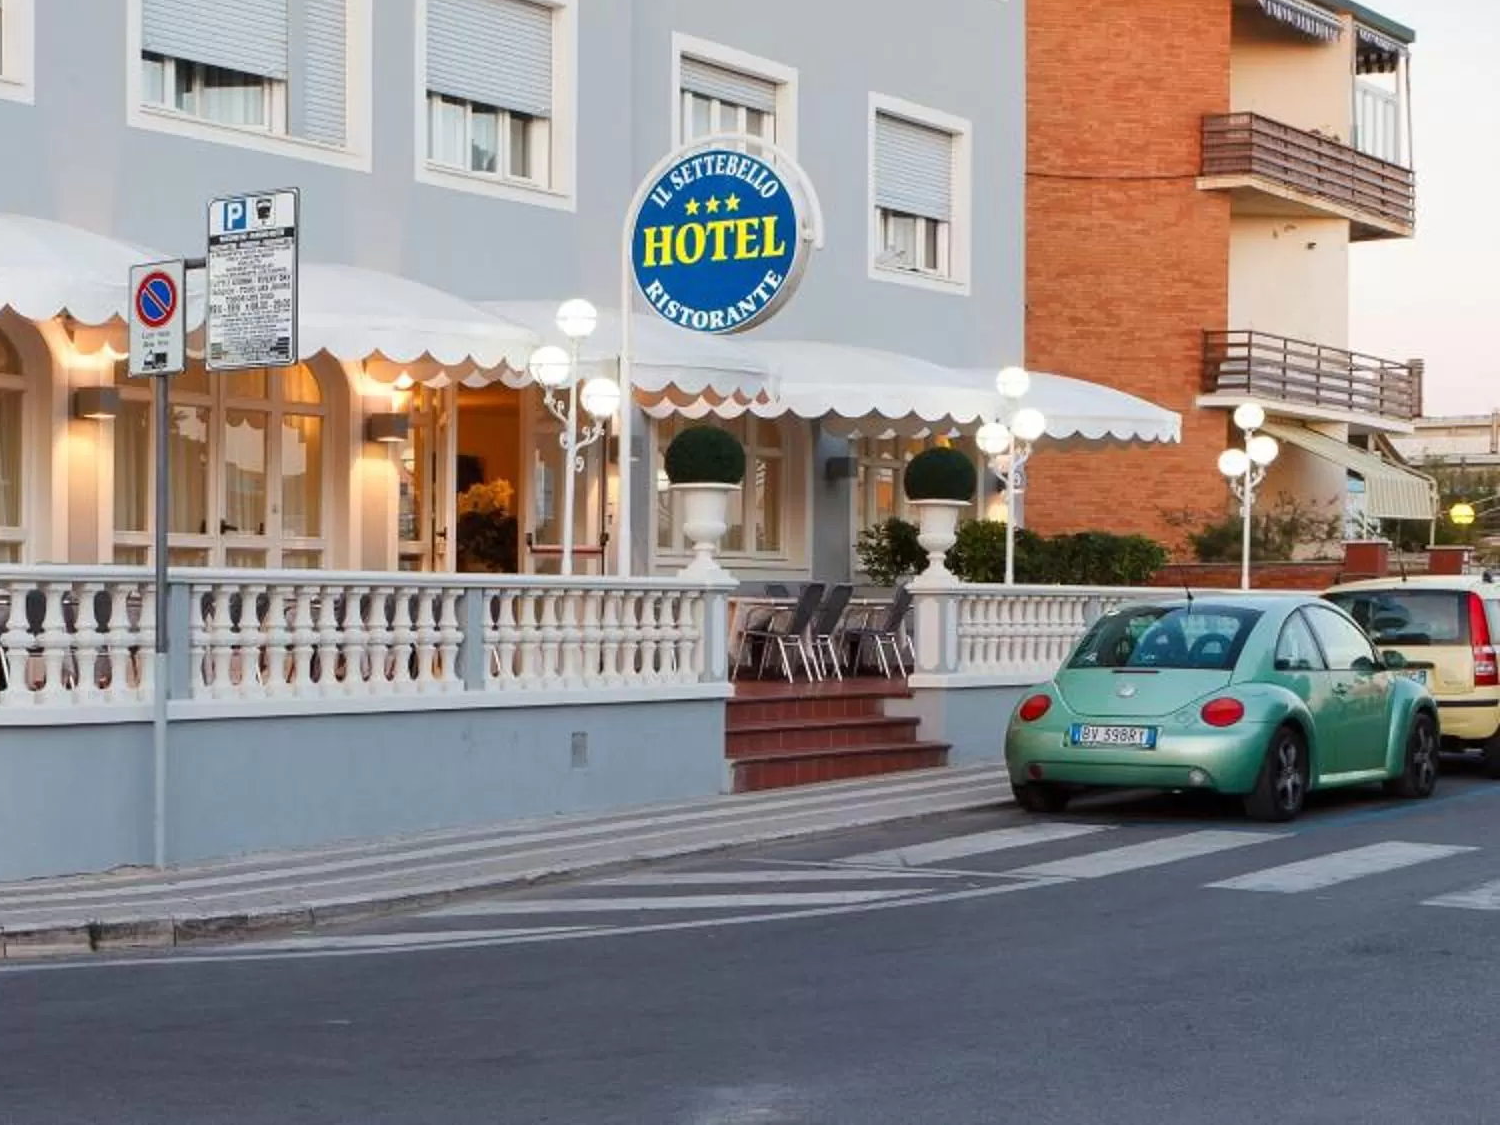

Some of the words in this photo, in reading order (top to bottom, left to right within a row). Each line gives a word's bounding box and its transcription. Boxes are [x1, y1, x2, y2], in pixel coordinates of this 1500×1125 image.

[650, 186, 673, 209] IL
[670, 154, 780, 199] SETTEBELLO
[227, 203, 243, 230] P
[642, 216, 786, 267] HOTEL
[645, 269, 783, 330] RISTORANTE
